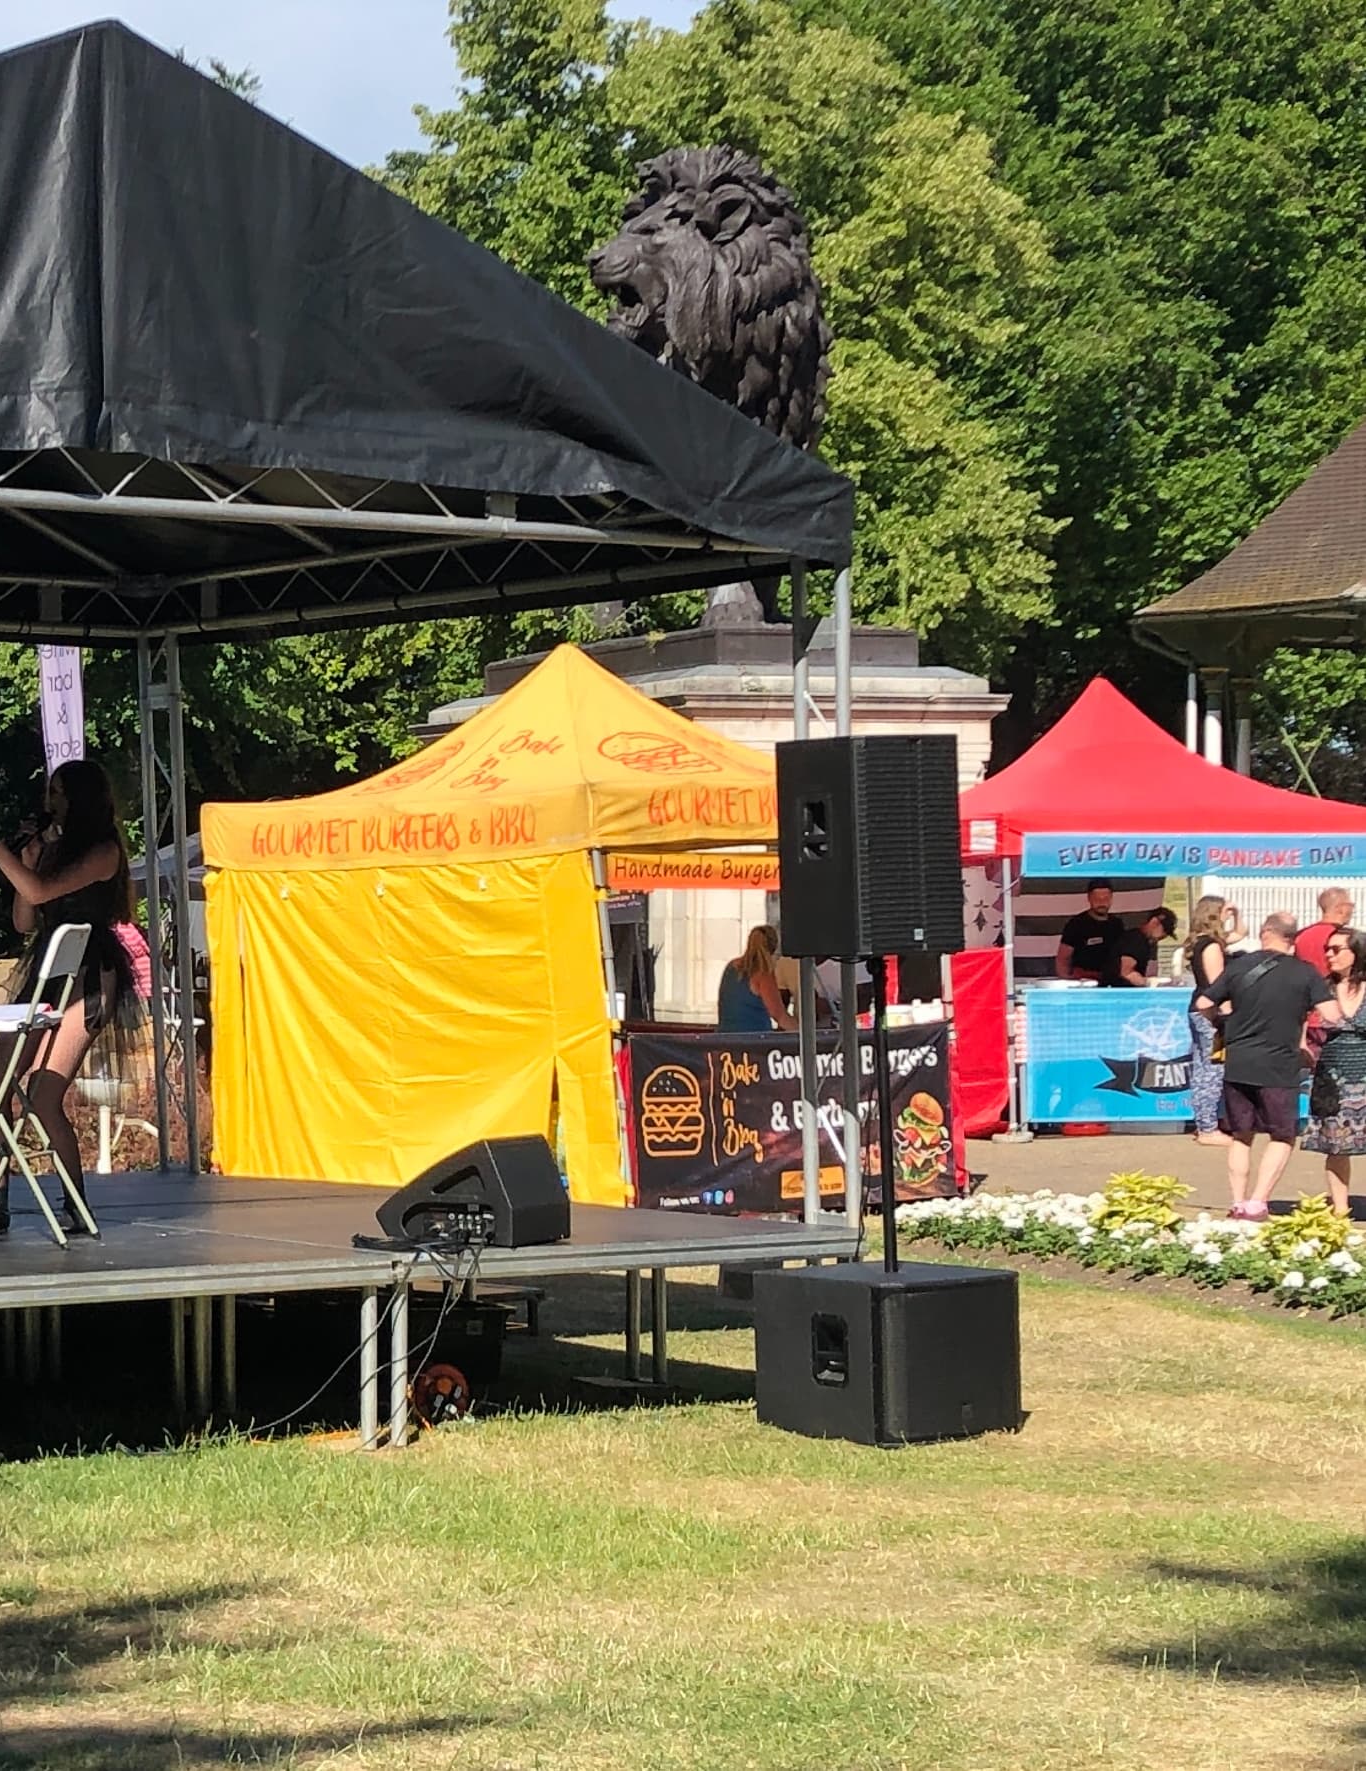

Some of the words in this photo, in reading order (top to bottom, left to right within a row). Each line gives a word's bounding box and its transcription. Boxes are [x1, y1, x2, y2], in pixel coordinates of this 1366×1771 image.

[647, 786, 754, 826] GOURMET
[251, 818, 358, 858] GOURMET
[362, 812, 461, 853] BURGERS
[469, 818, 482, 845] &
[490, 804, 537, 846] BBQ
[614, 856, 714, 879] Handmade
[1057, 842, 1129, 867] EVERY
[1135, 842, 1175, 862] DAY
[1182, 846, 1202, 864] IS
[1207, 846, 1303, 867] PANCAKE
[1309, 844, 1354, 864] DAY!
[719, 1052, 760, 1089] Bake
[770, 1100, 791, 1132] &
[722, 1118, 764, 1164] Bbq
